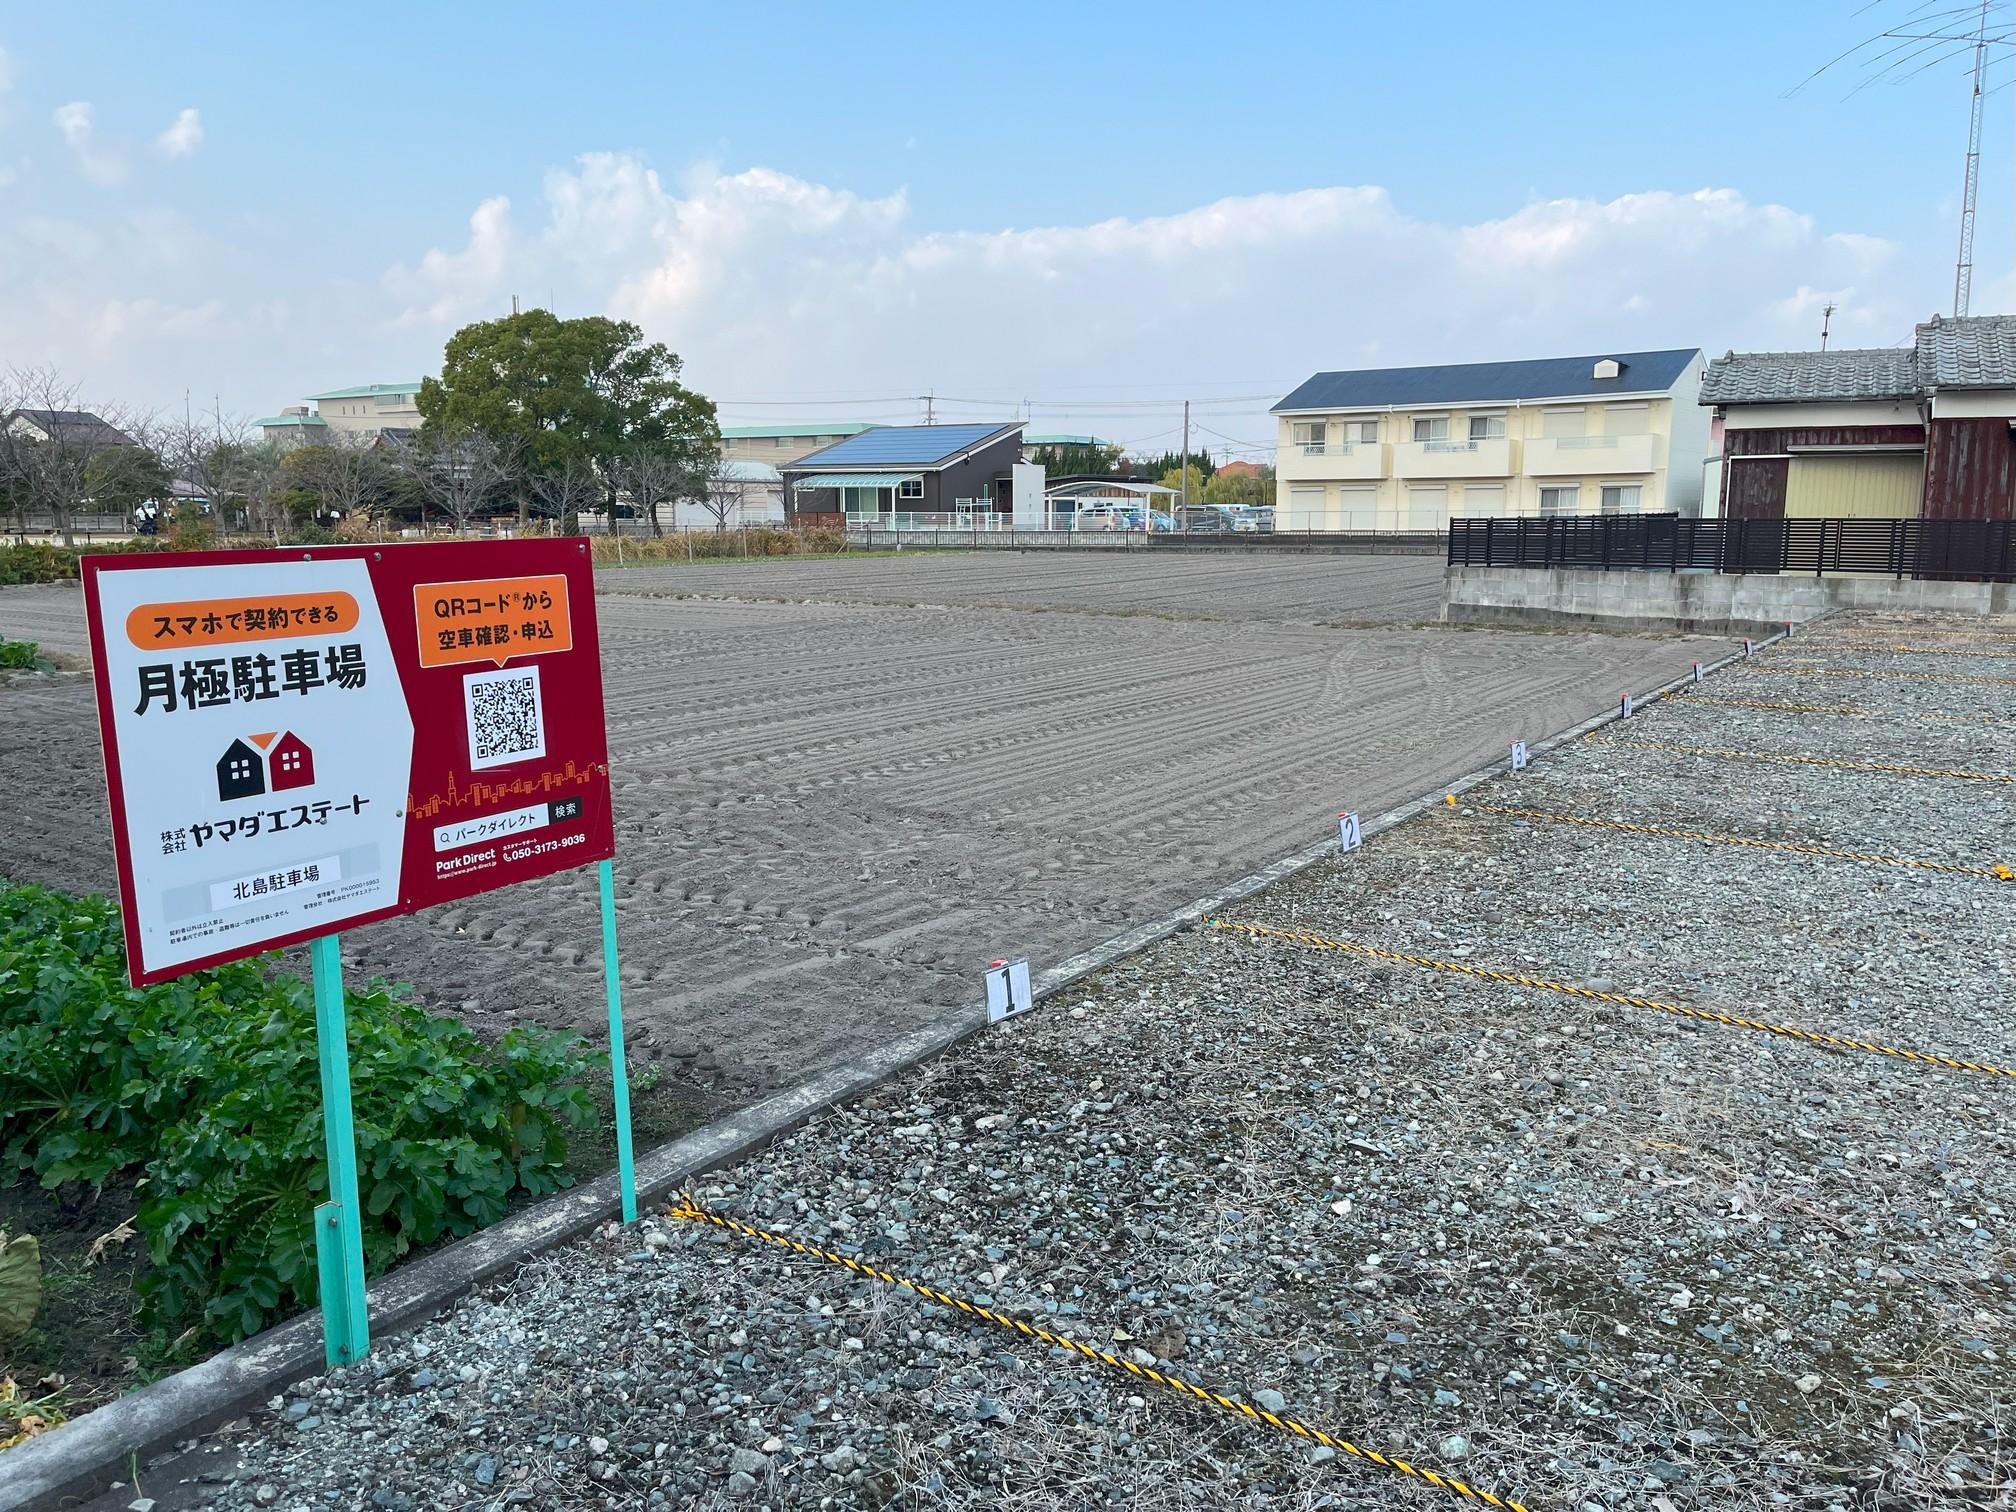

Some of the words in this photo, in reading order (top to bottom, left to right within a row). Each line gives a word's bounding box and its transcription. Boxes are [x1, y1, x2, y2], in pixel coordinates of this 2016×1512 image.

[153, 606, 339, 638] スマホで契約できる
[438, 620, 554, 650] 空車確認・申込
[133, 643, 367, 716] 月極駐車場
[554, 802, 577, 819] 検索
[160, 827, 186, 843] 株式
[455, 813, 536, 841] パークダイレクト
[1345, 818, 1356, 848] 2
[161, 840, 187, 855] 会社
[436, 856, 462, 873] Park
[463, 848, 496, 866] Direct
[511, 833, 586, 861] 050-3173-9036
[232, 864, 320, 901] 北島駐車場
[1001, 968, 1015, 1013] 1
